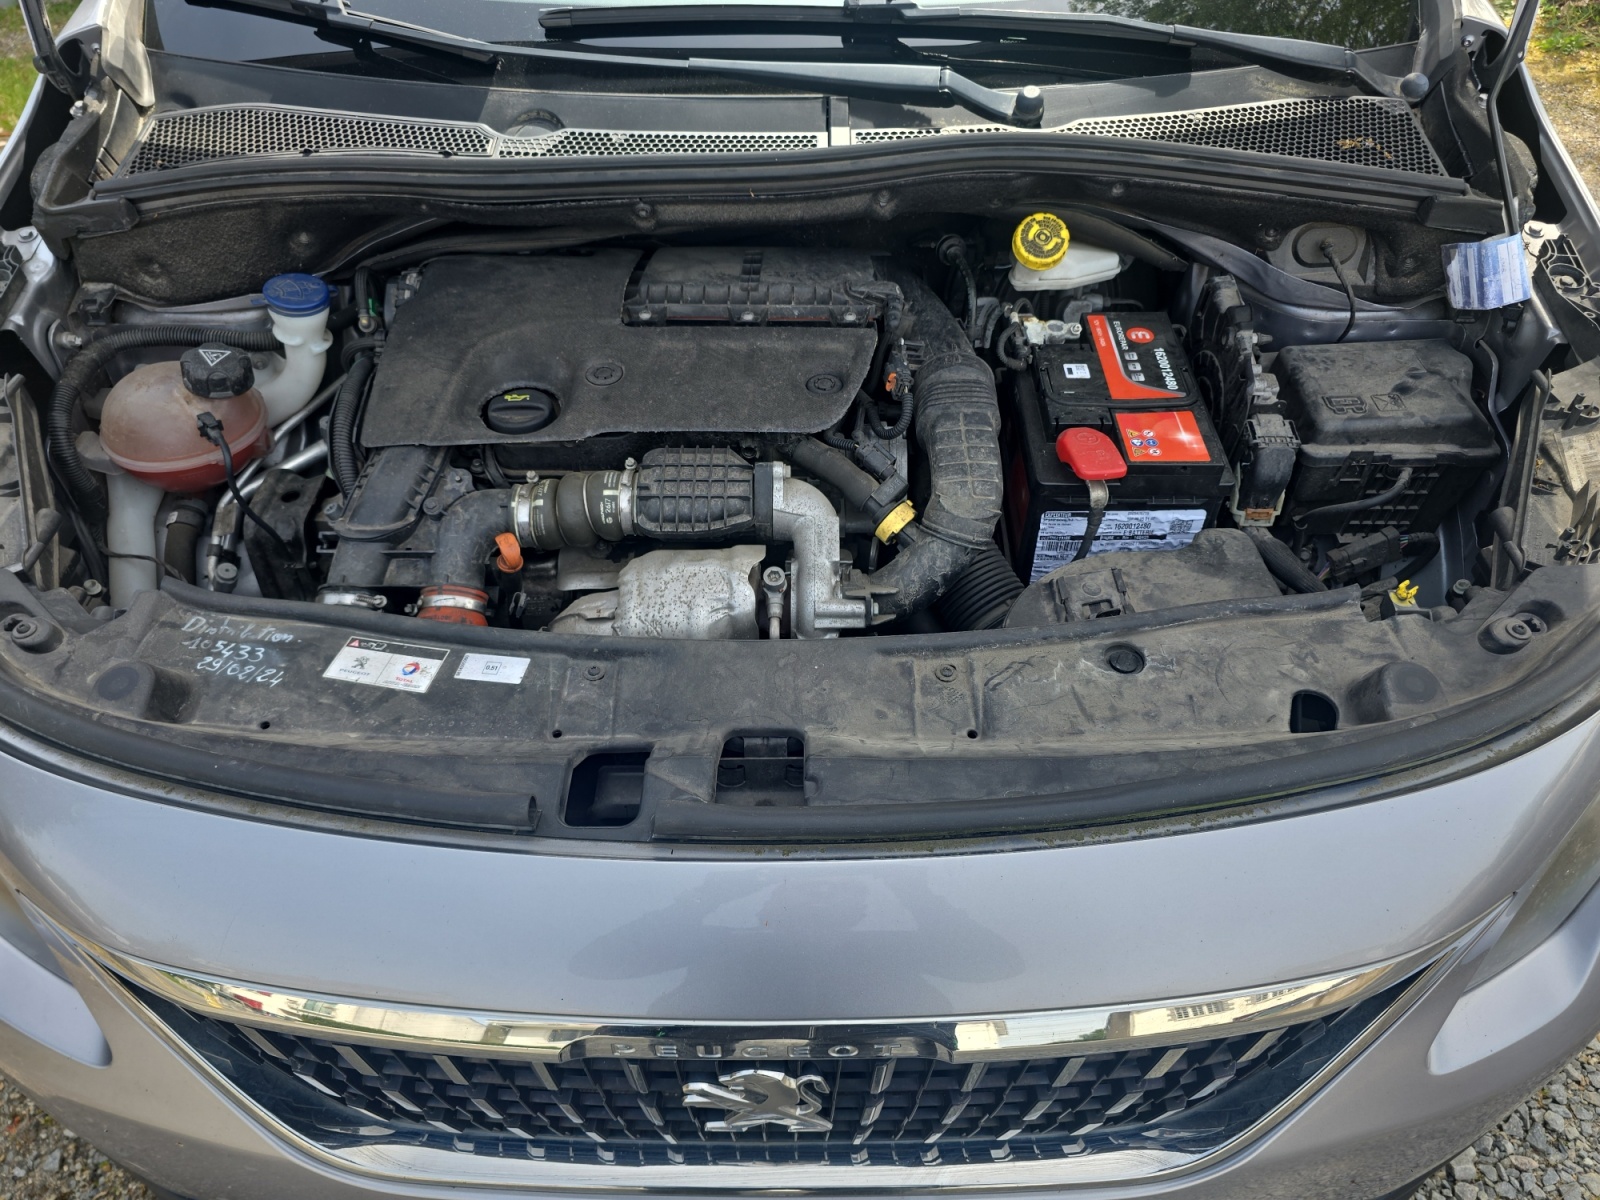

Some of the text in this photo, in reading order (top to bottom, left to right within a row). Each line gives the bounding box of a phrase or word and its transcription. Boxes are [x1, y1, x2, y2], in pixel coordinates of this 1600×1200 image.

[1113, 320, 1128, 350] EUROREPAR
[1153, 347, 1178, 390] 1620012480
[196, 656, 285, 688] 29/02/24
[339, 668, 371, 676] PEUGEOT
[610, 1043, 902, 1058] PEUGEOT
